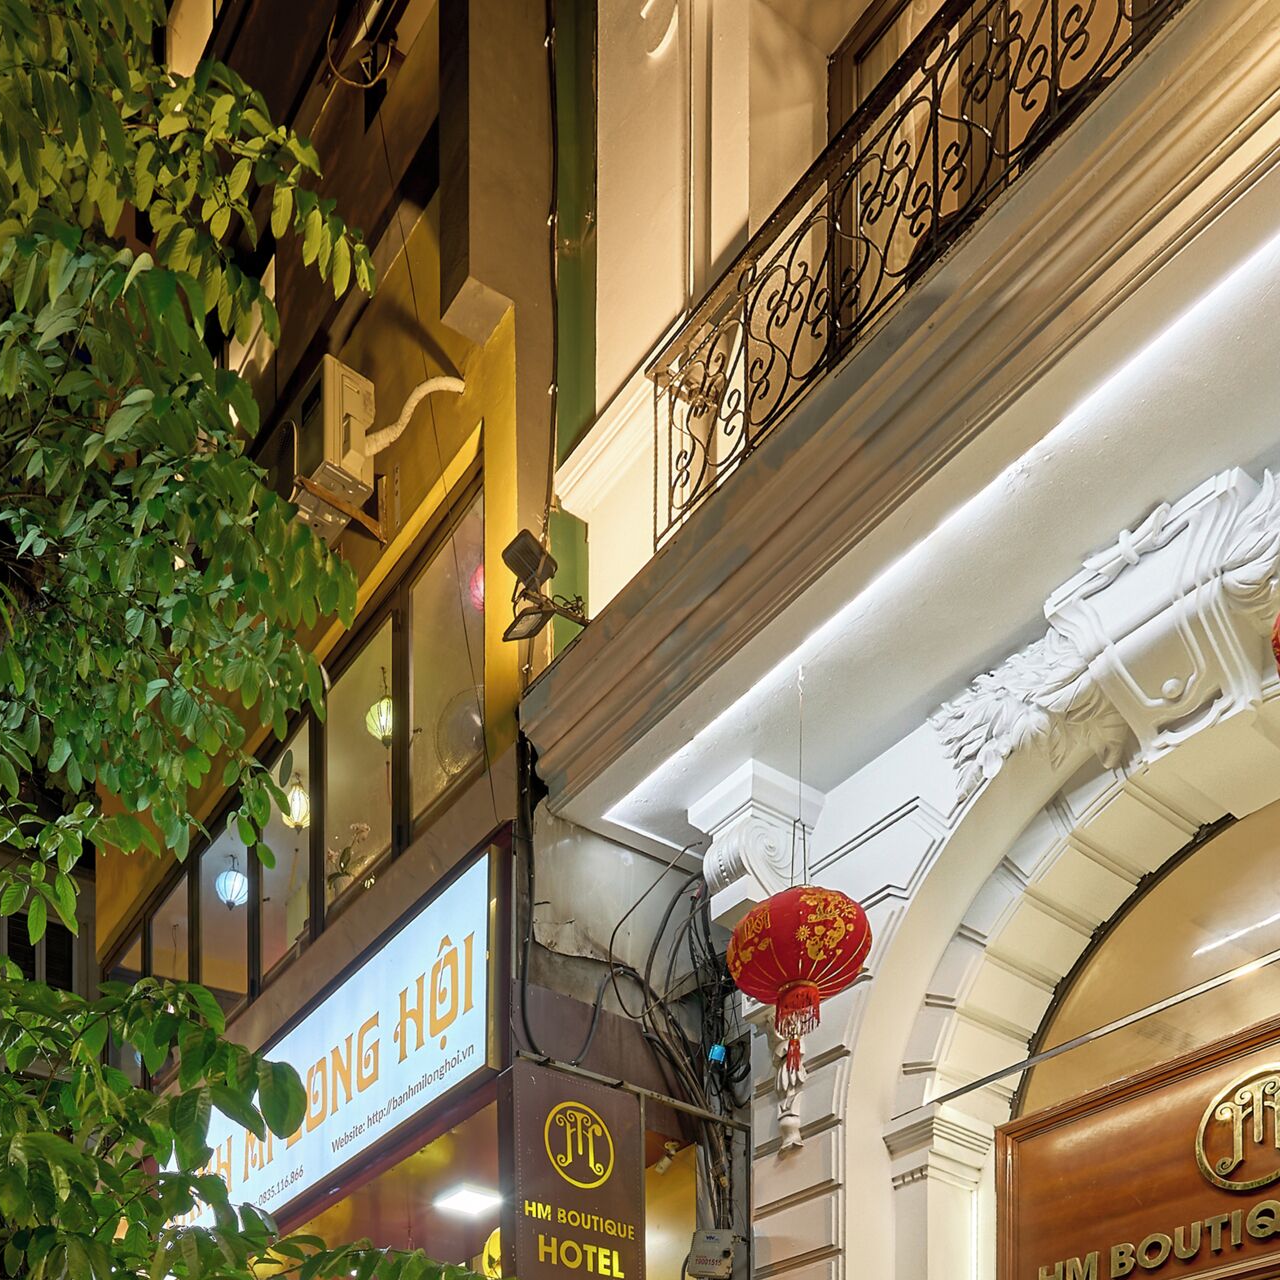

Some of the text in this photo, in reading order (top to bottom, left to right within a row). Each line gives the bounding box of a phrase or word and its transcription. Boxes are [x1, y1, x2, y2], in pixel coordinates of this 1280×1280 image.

[393, 930, 476, 1066] HỘI
[331, 1043, 475, 1153] Website: http://banhmilonghoi.vn
[524, 1199, 635, 1241] HM BOUTIQUE
[538, 1233, 626, 1280] HOTEL
